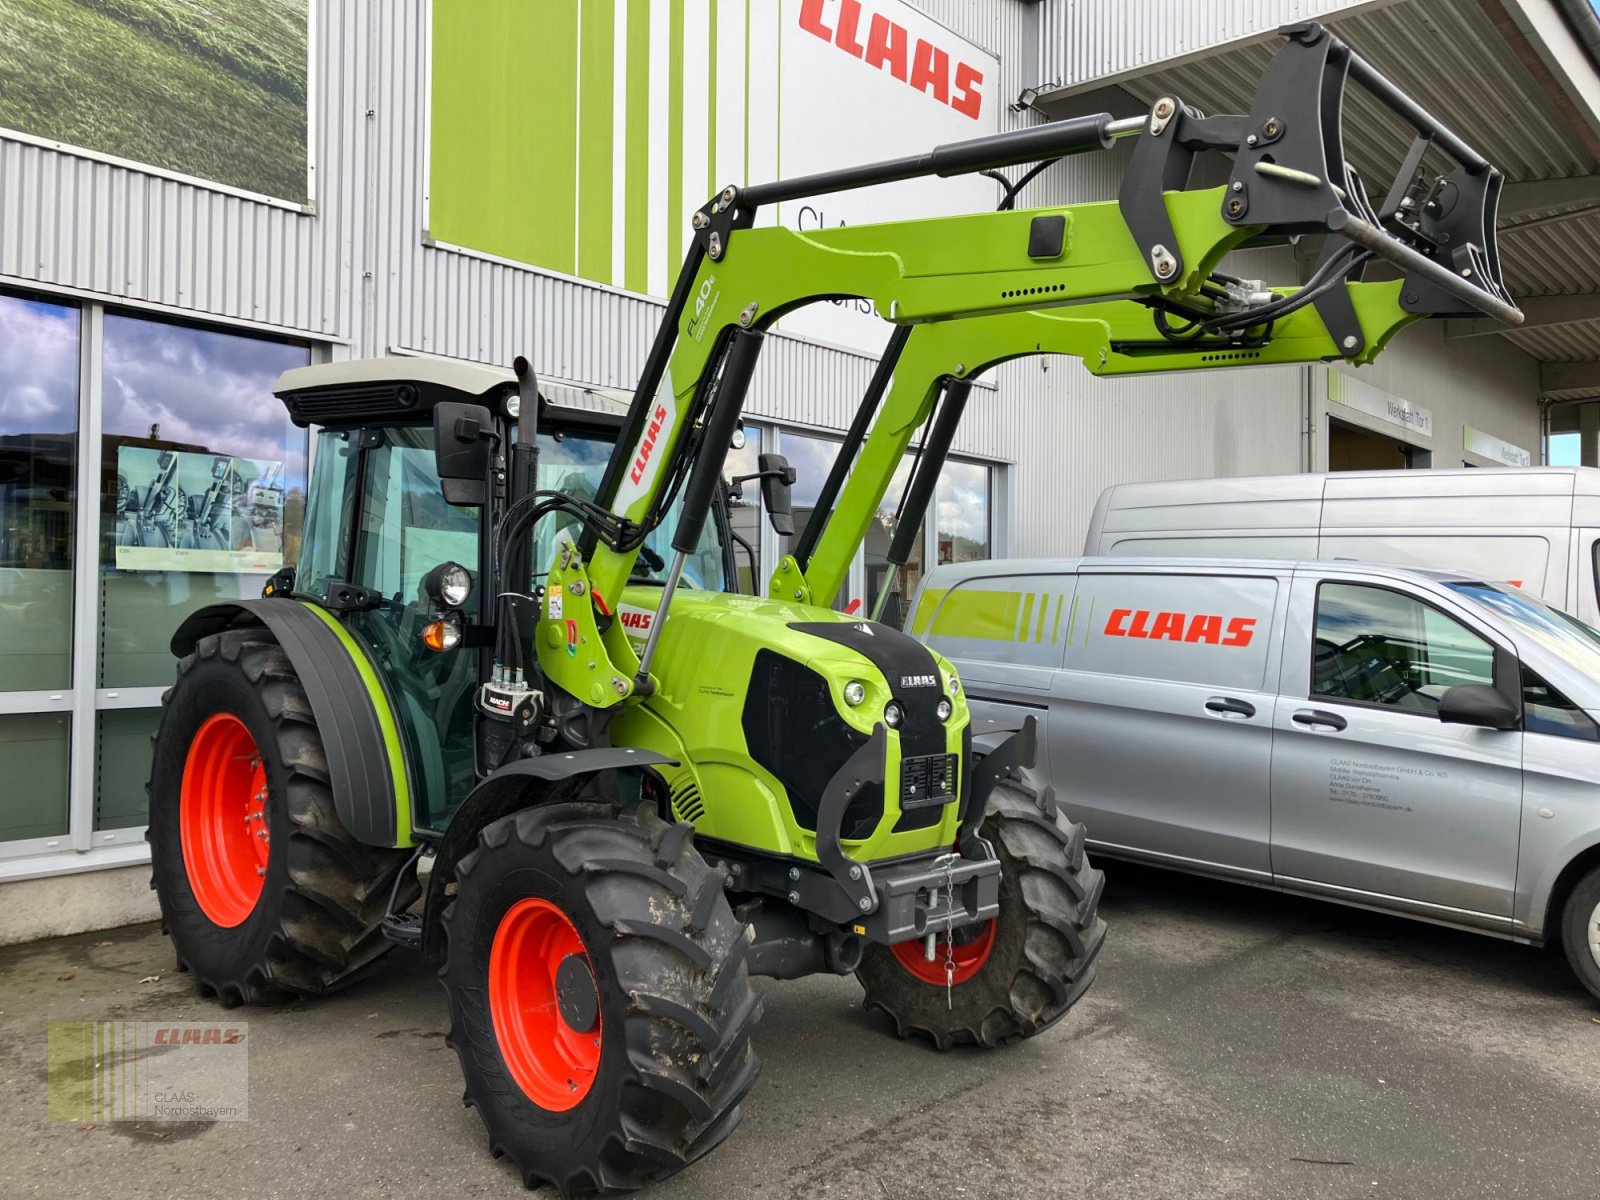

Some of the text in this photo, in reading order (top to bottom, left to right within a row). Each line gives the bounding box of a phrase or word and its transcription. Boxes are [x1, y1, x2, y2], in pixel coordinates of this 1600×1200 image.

[799, 0, 983, 120] CLAAS
[1387, 400, 1414, 424] Werkstatt
[630, 404, 667, 486] CLAAS
[621, 612, 651, 630] AAS
[1103, 608, 1257, 647] CLAAS
[901, 675, 936, 688] CLAAS
[1329, 774, 1350, 782] CLAAS
[1330, 759, 1351, 767] CLAAS
[1396, 766, 1418, 776] GmbH
[1437, 771, 1448, 779] KG
